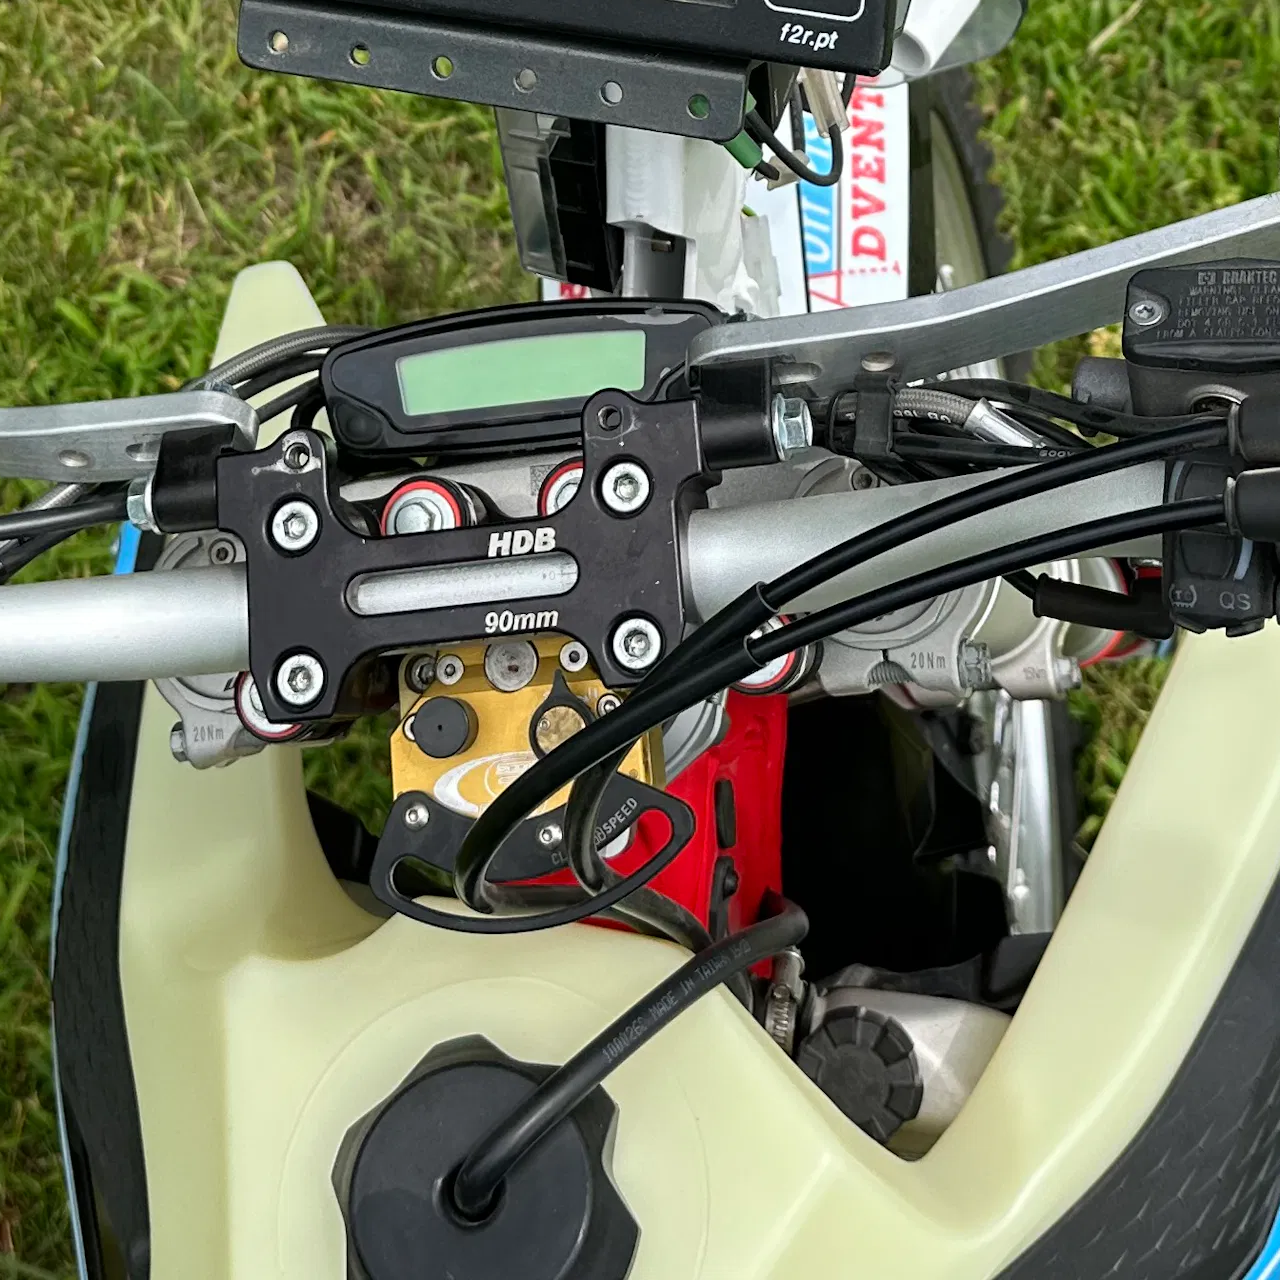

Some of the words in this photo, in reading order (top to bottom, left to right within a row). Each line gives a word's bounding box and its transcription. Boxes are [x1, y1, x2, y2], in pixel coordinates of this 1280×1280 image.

[780, 22, 839, 52] f2r.pt
[487, 526, 557, 558] HDB
[1219, 590, 1252, 611] QS
[484, 609, 559, 634] 90mm
